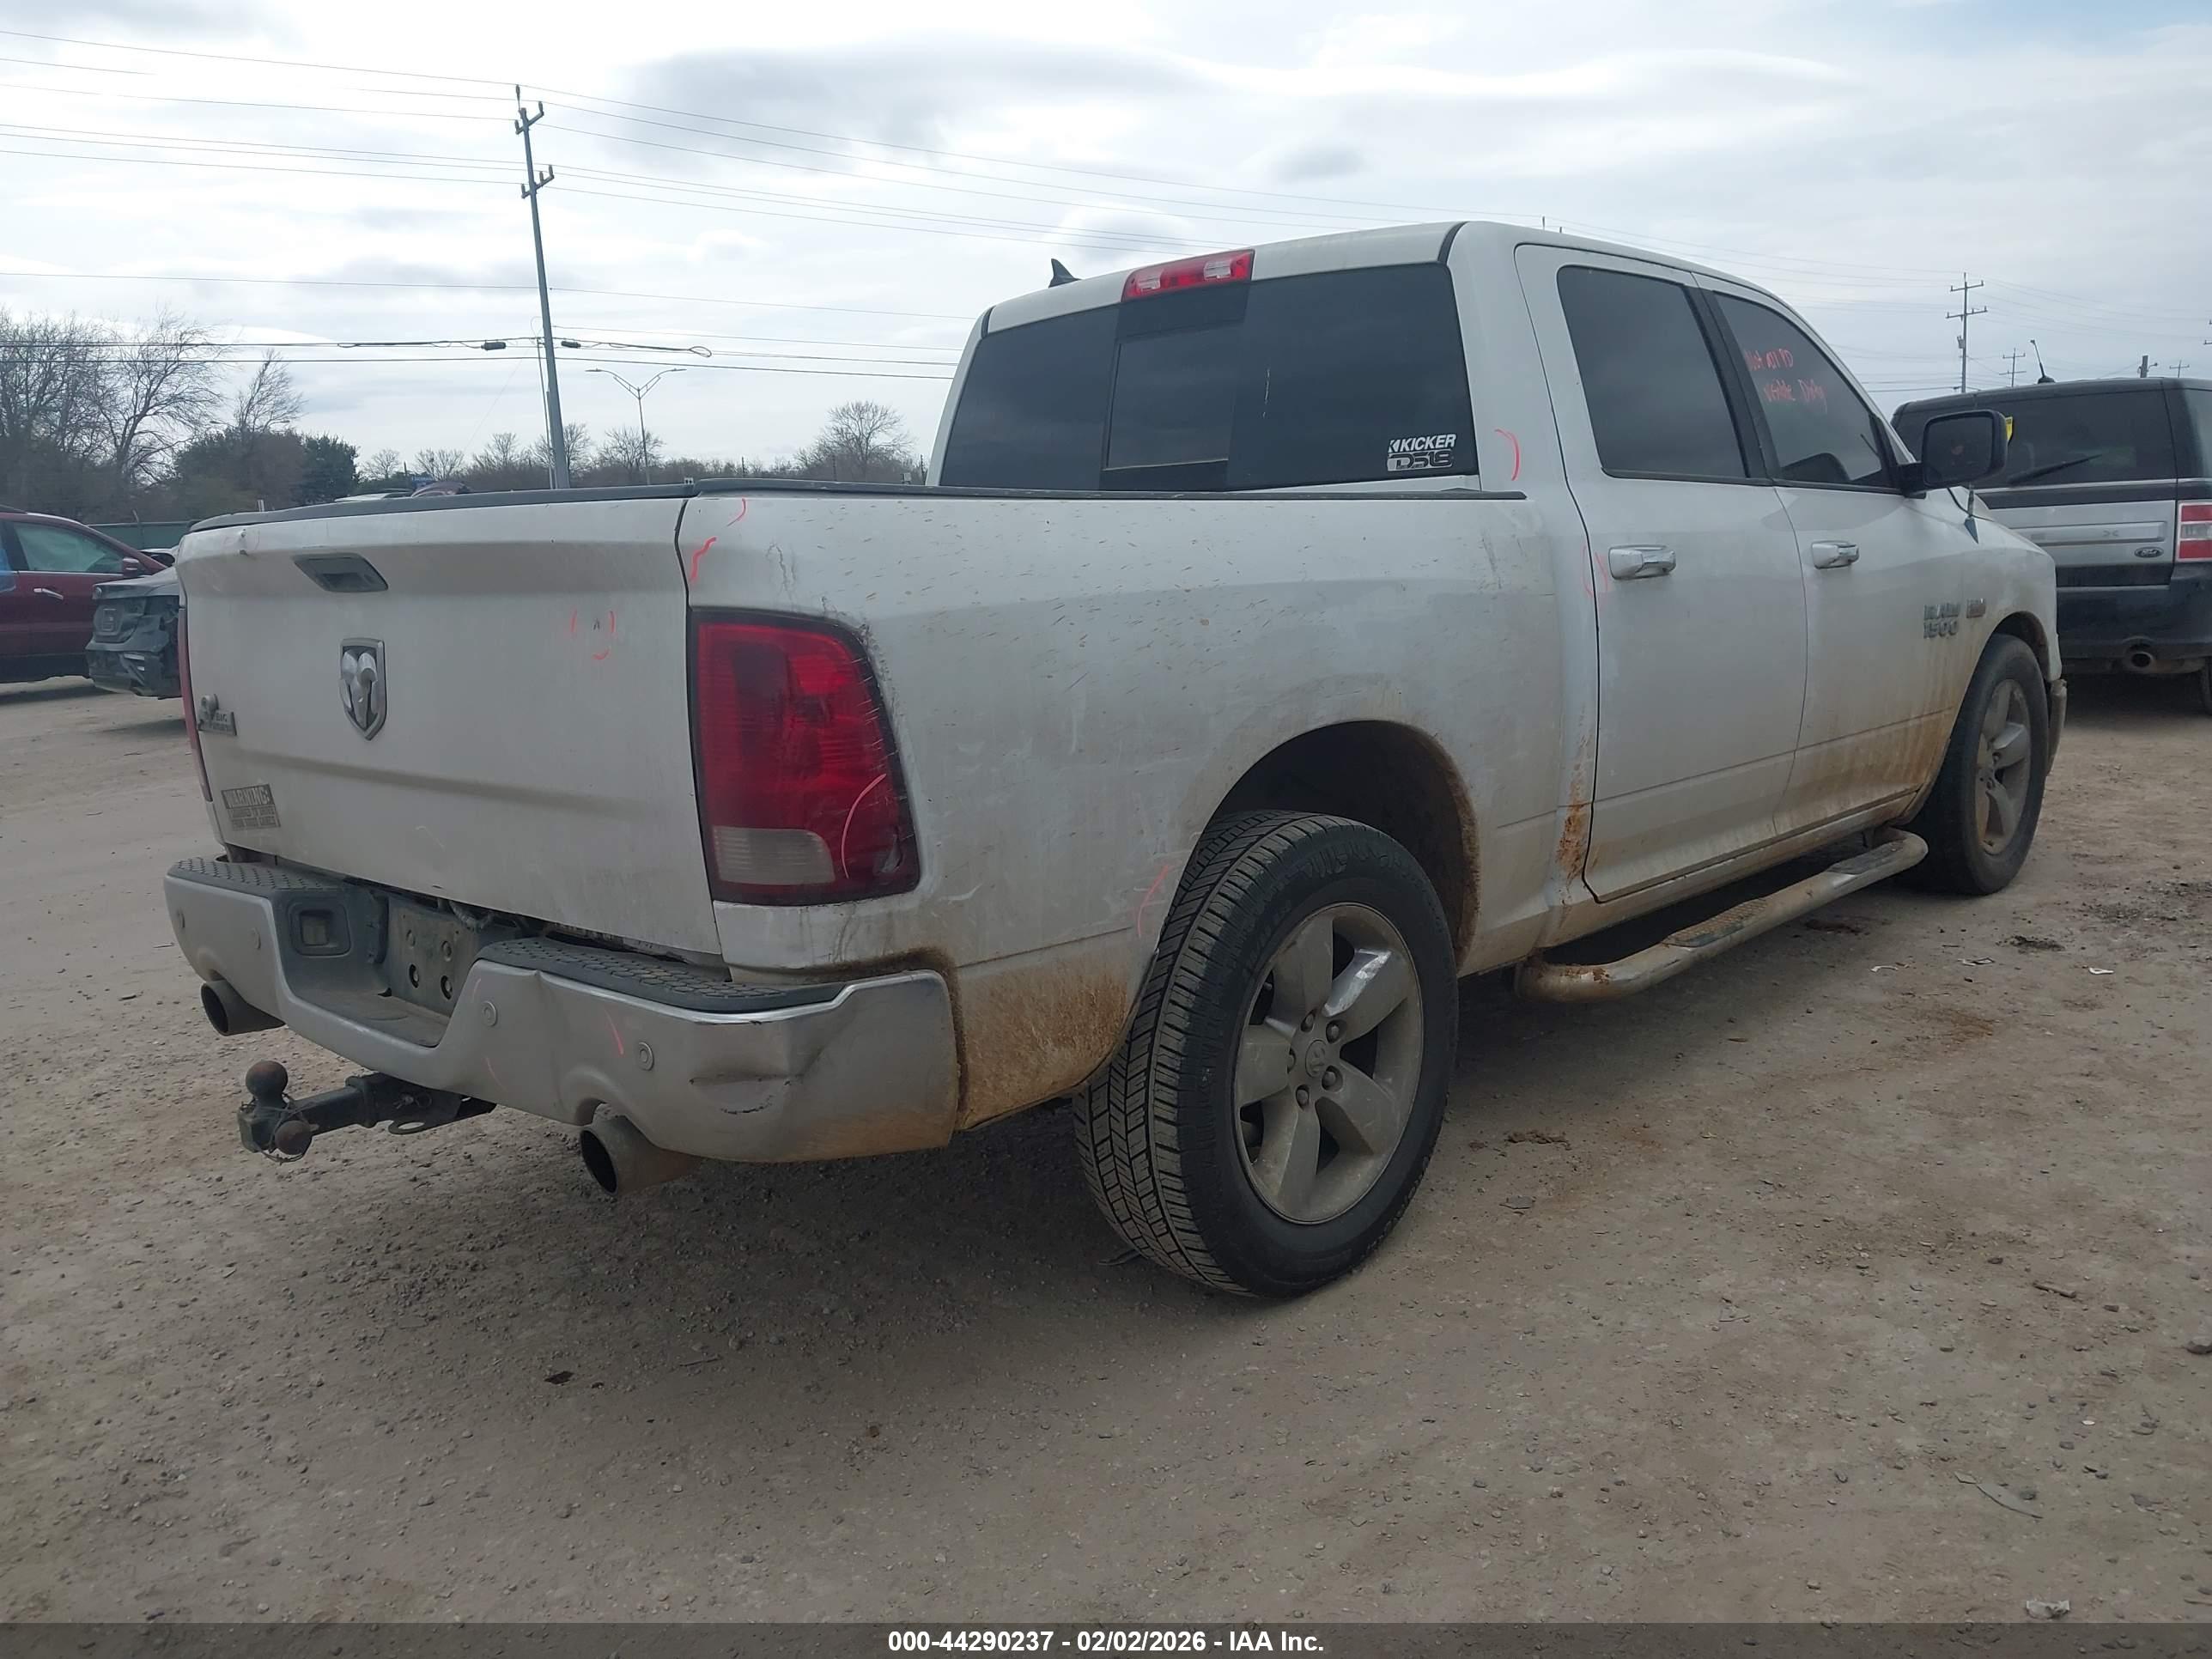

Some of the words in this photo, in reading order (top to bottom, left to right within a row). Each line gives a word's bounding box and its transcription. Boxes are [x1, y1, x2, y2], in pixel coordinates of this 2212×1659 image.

[1399, 434, 1457, 452] KICKER
[1923, 603, 1960, 619] RAM
[1923, 617, 1959, 638] 1500
